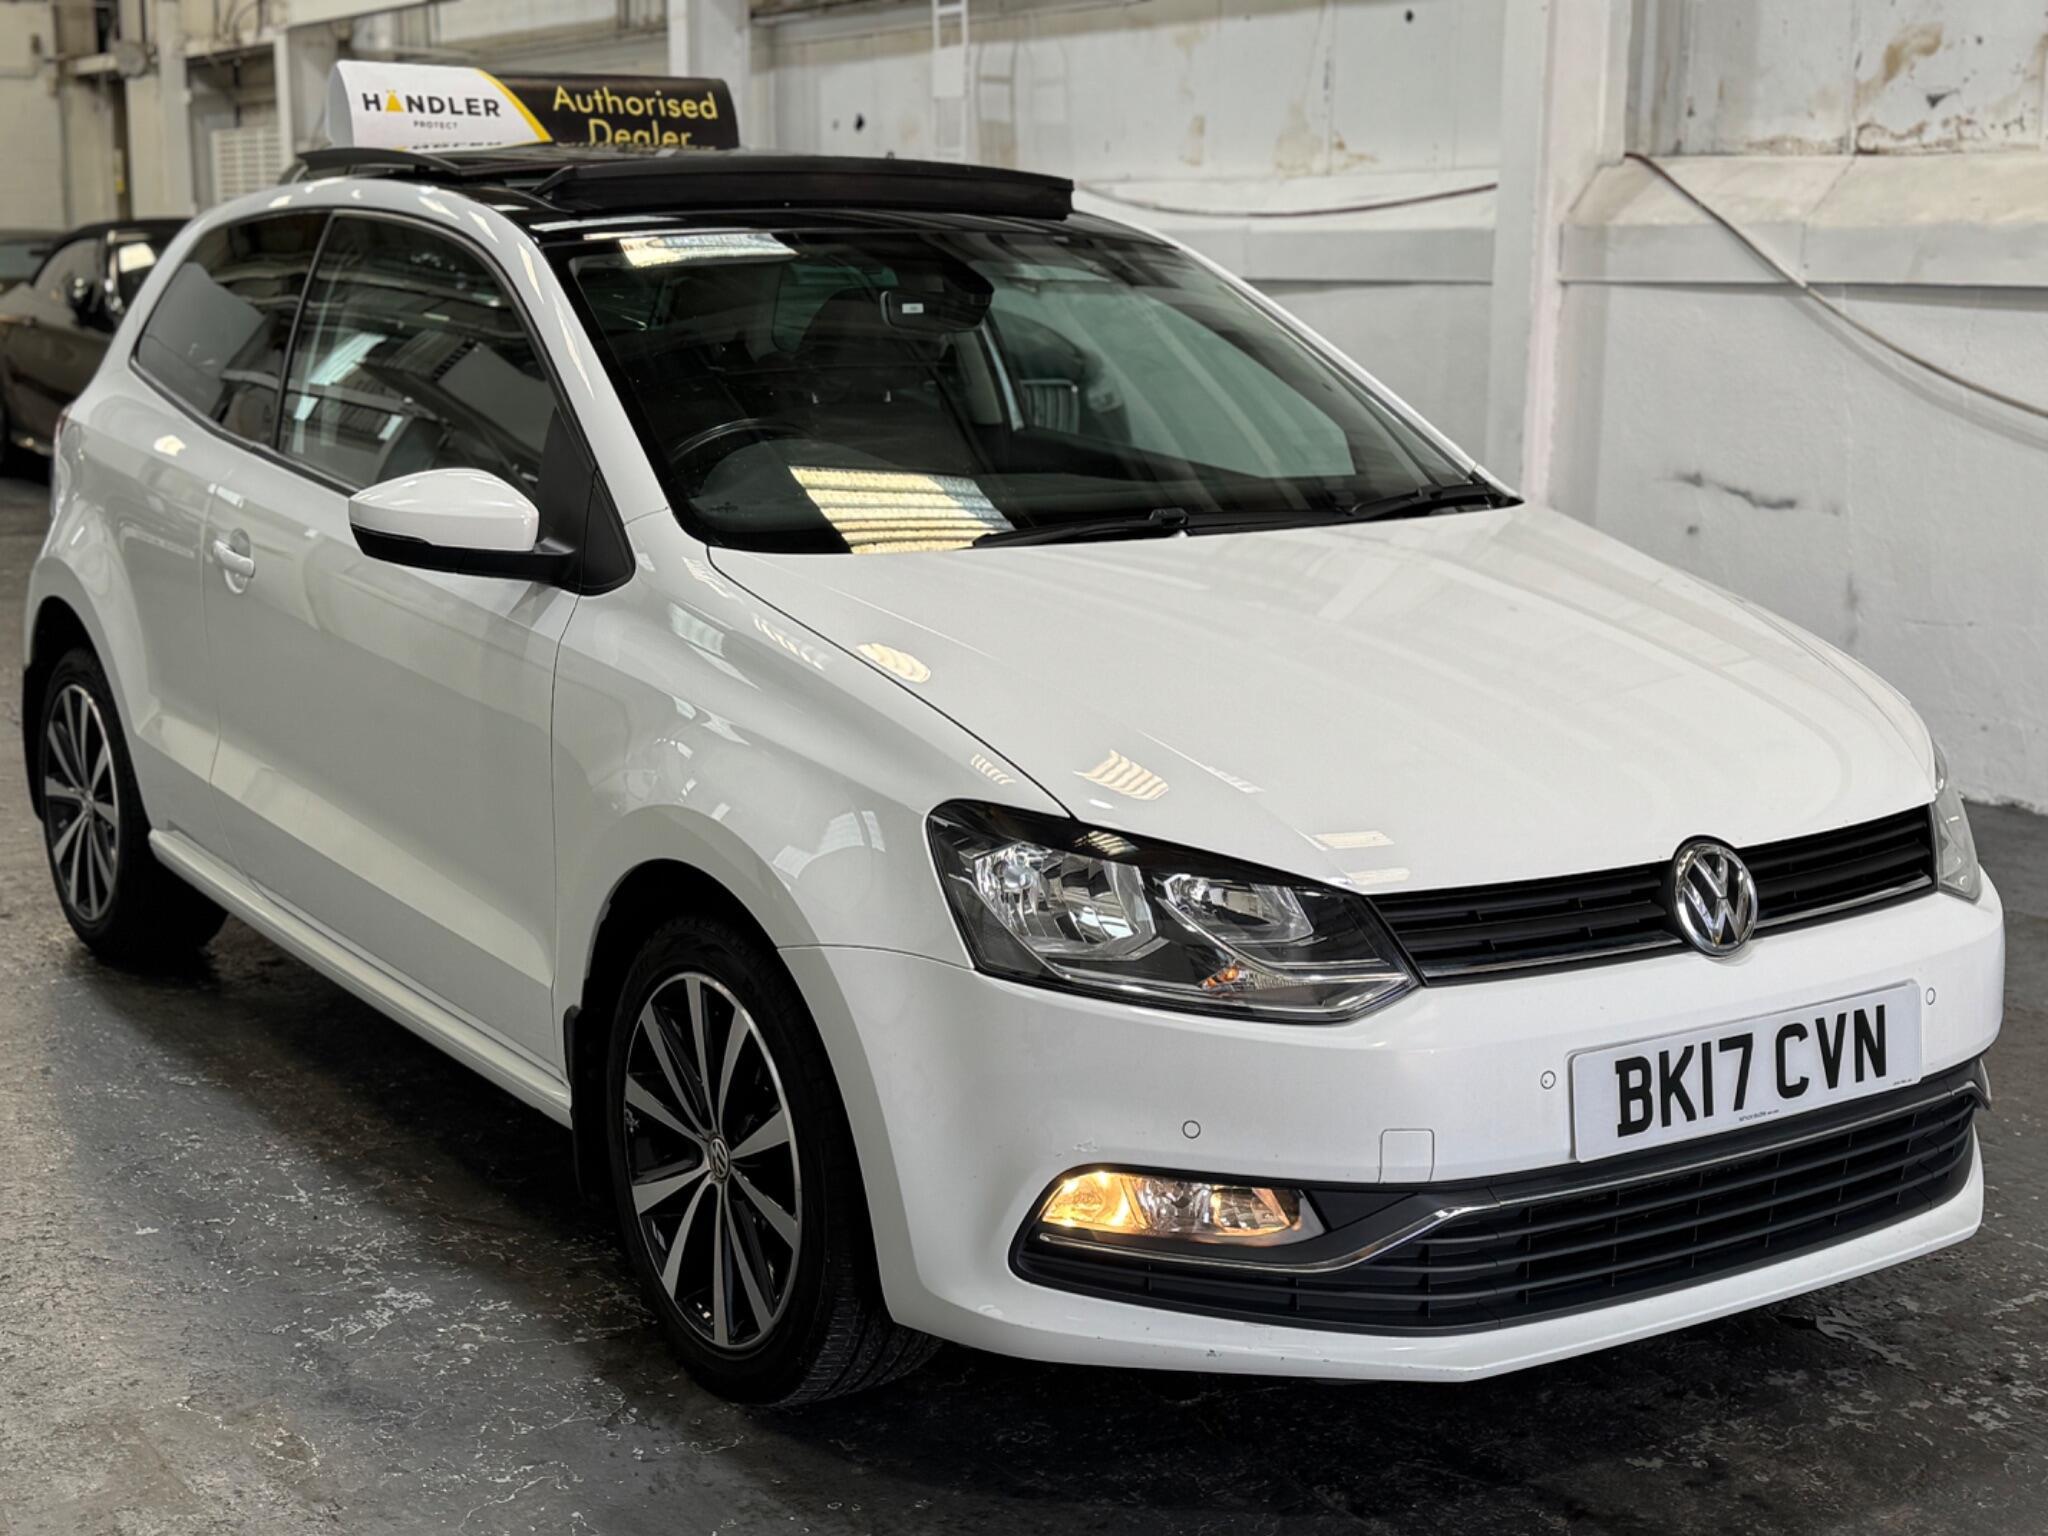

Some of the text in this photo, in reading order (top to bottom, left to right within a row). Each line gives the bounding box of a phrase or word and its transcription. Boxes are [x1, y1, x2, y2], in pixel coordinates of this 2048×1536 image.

[553, 84, 718, 120] Authorised
[413, 120, 458, 130] PROTECT
[588, 118, 692, 146] Dealer
[1614, 1003, 1887, 1138] BK17 CVN
